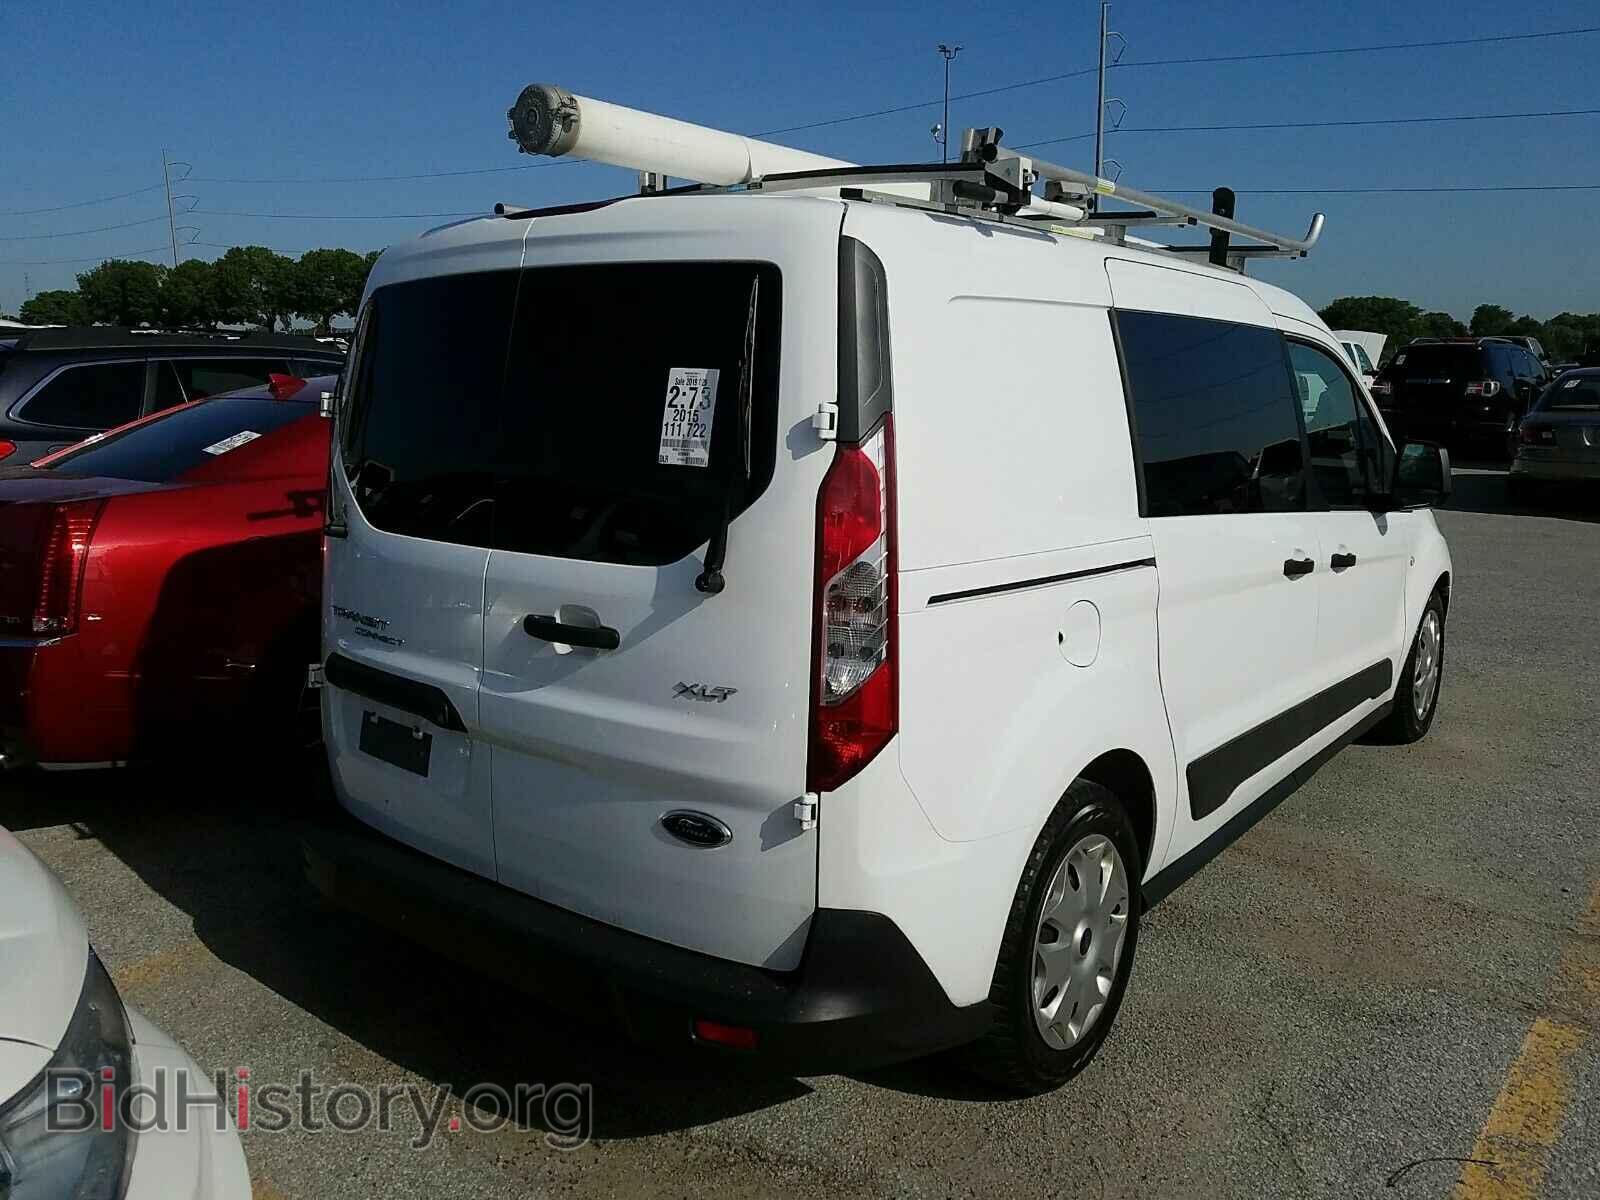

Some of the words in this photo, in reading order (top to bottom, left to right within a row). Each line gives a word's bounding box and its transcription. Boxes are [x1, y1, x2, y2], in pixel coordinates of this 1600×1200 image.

[668, 386, 710, 410] 2:73
[672, 409, 699, 423] 2015
[664, 422, 706, 439] 111,722
[329, 605, 391, 631] TRANSIT
[354, 627, 405, 646] CONNECT
[672, 682, 738, 703] XLT
